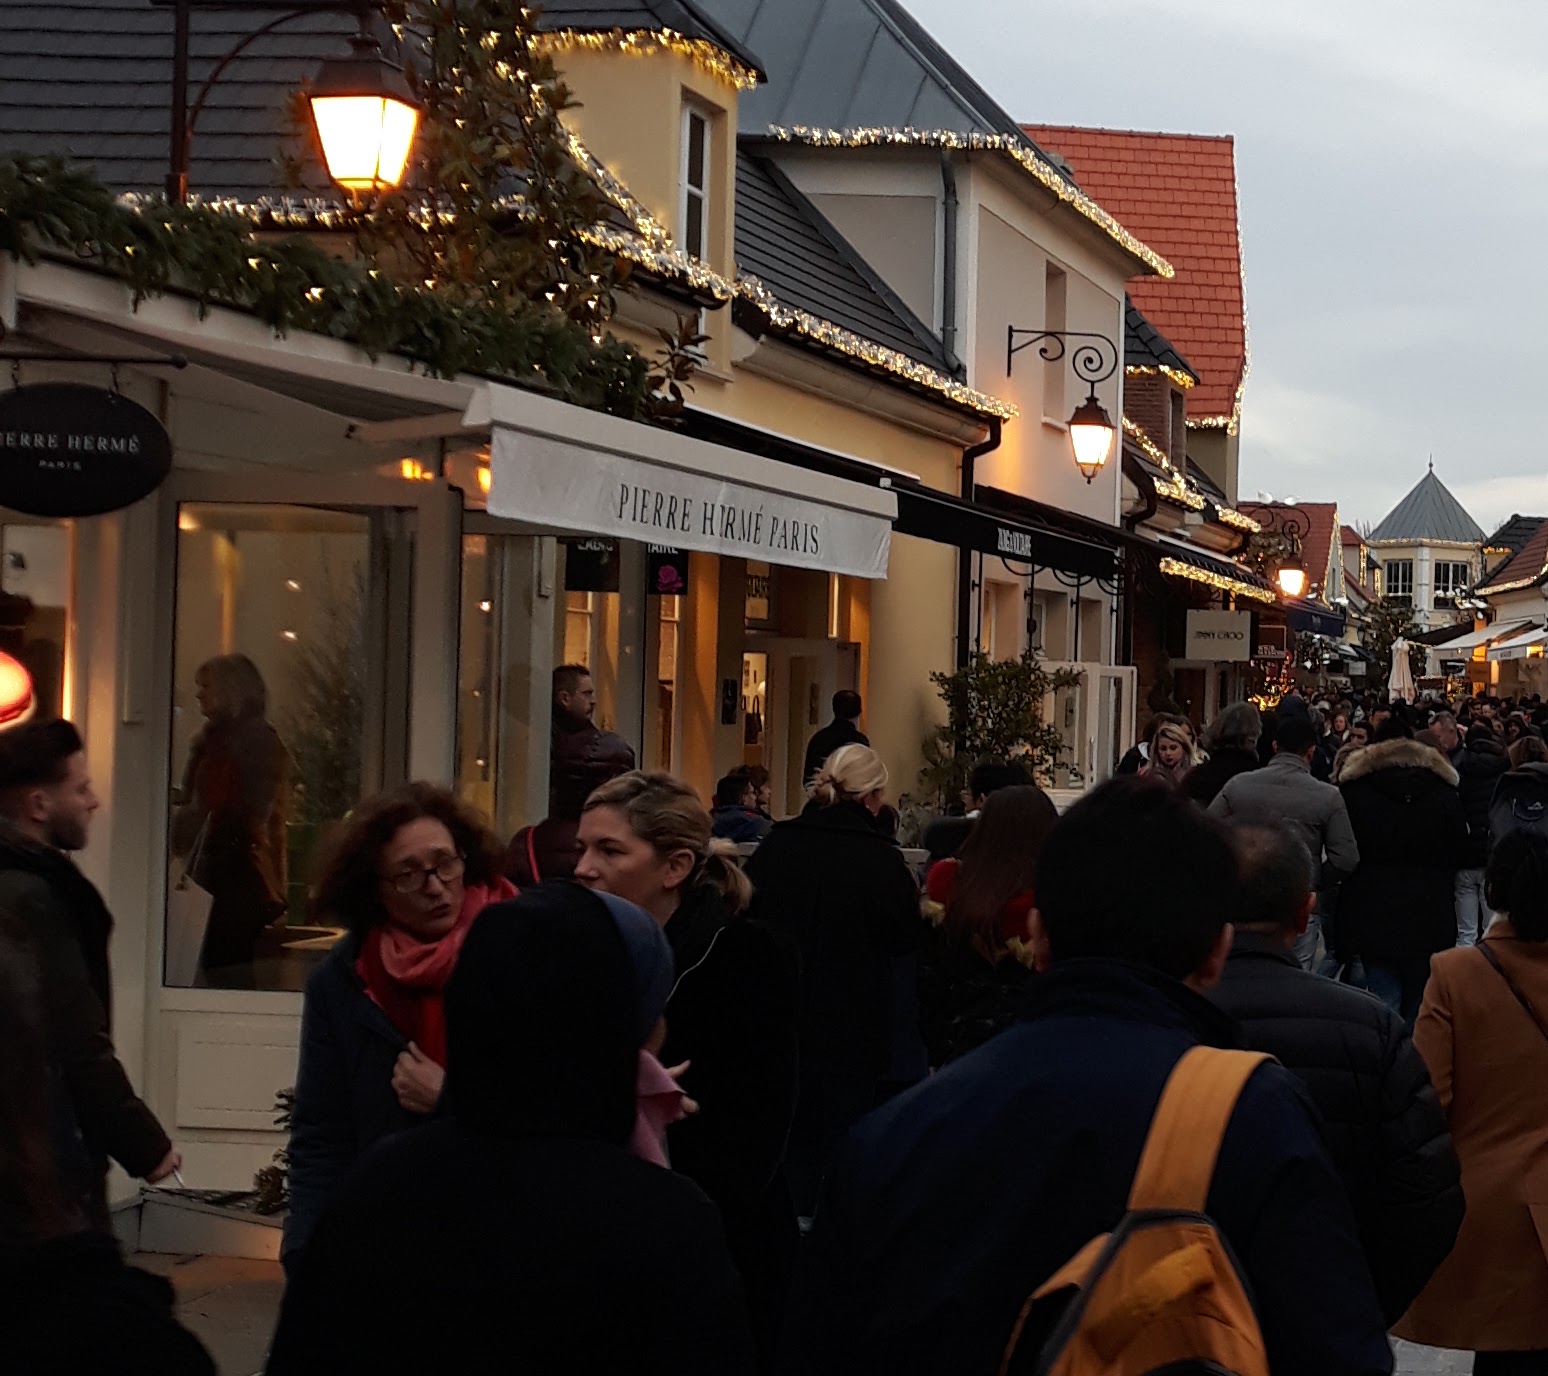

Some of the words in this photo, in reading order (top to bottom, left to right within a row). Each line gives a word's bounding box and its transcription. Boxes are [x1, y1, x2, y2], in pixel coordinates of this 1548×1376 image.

[67, 433, 141, 455] HERMÉ
[617, 483, 693, 533] PIERRE
[768, 516, 821, 556] PARIS
